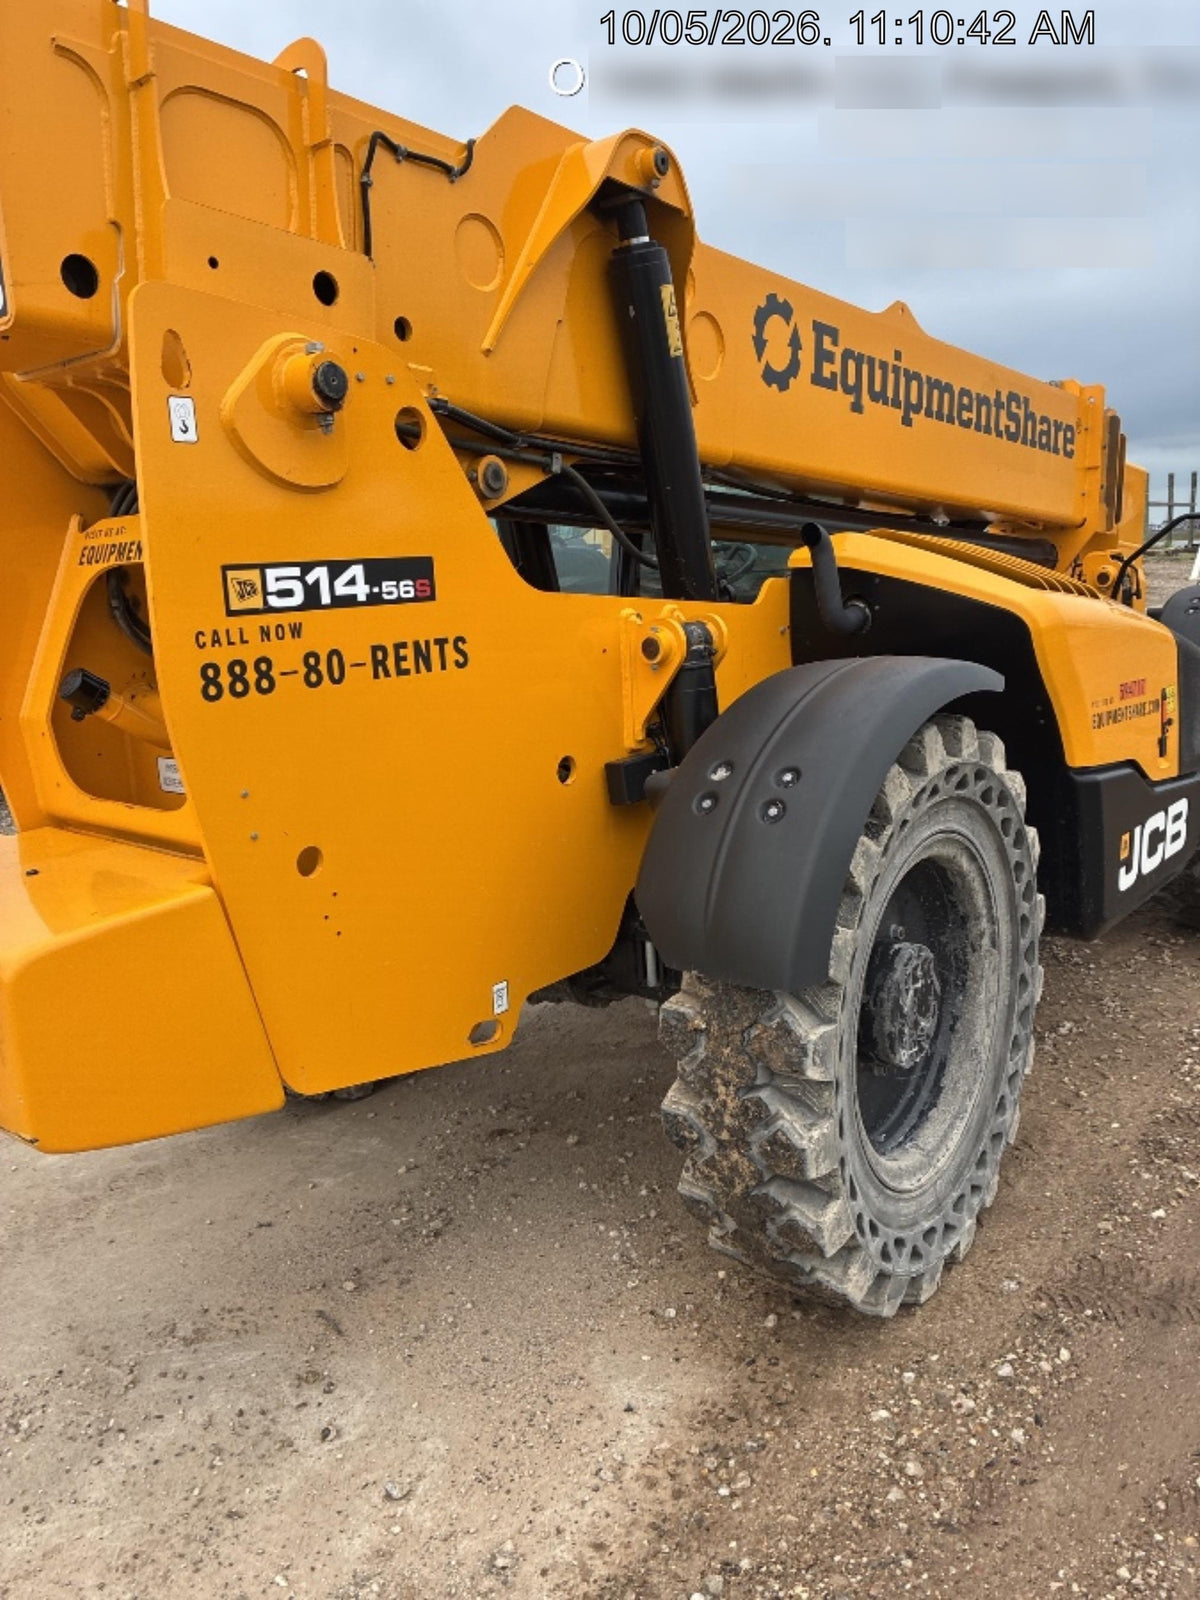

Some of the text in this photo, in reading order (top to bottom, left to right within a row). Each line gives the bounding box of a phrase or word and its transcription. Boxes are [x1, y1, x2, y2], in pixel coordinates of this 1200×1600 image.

[810, 319, 1075, 459] EquipmentShare
[195, 622, 303, 649] CALL NOW
[200, 635, 469, 702] 888-80-RENTS
[1118, 797, 1189, 892] JCB
